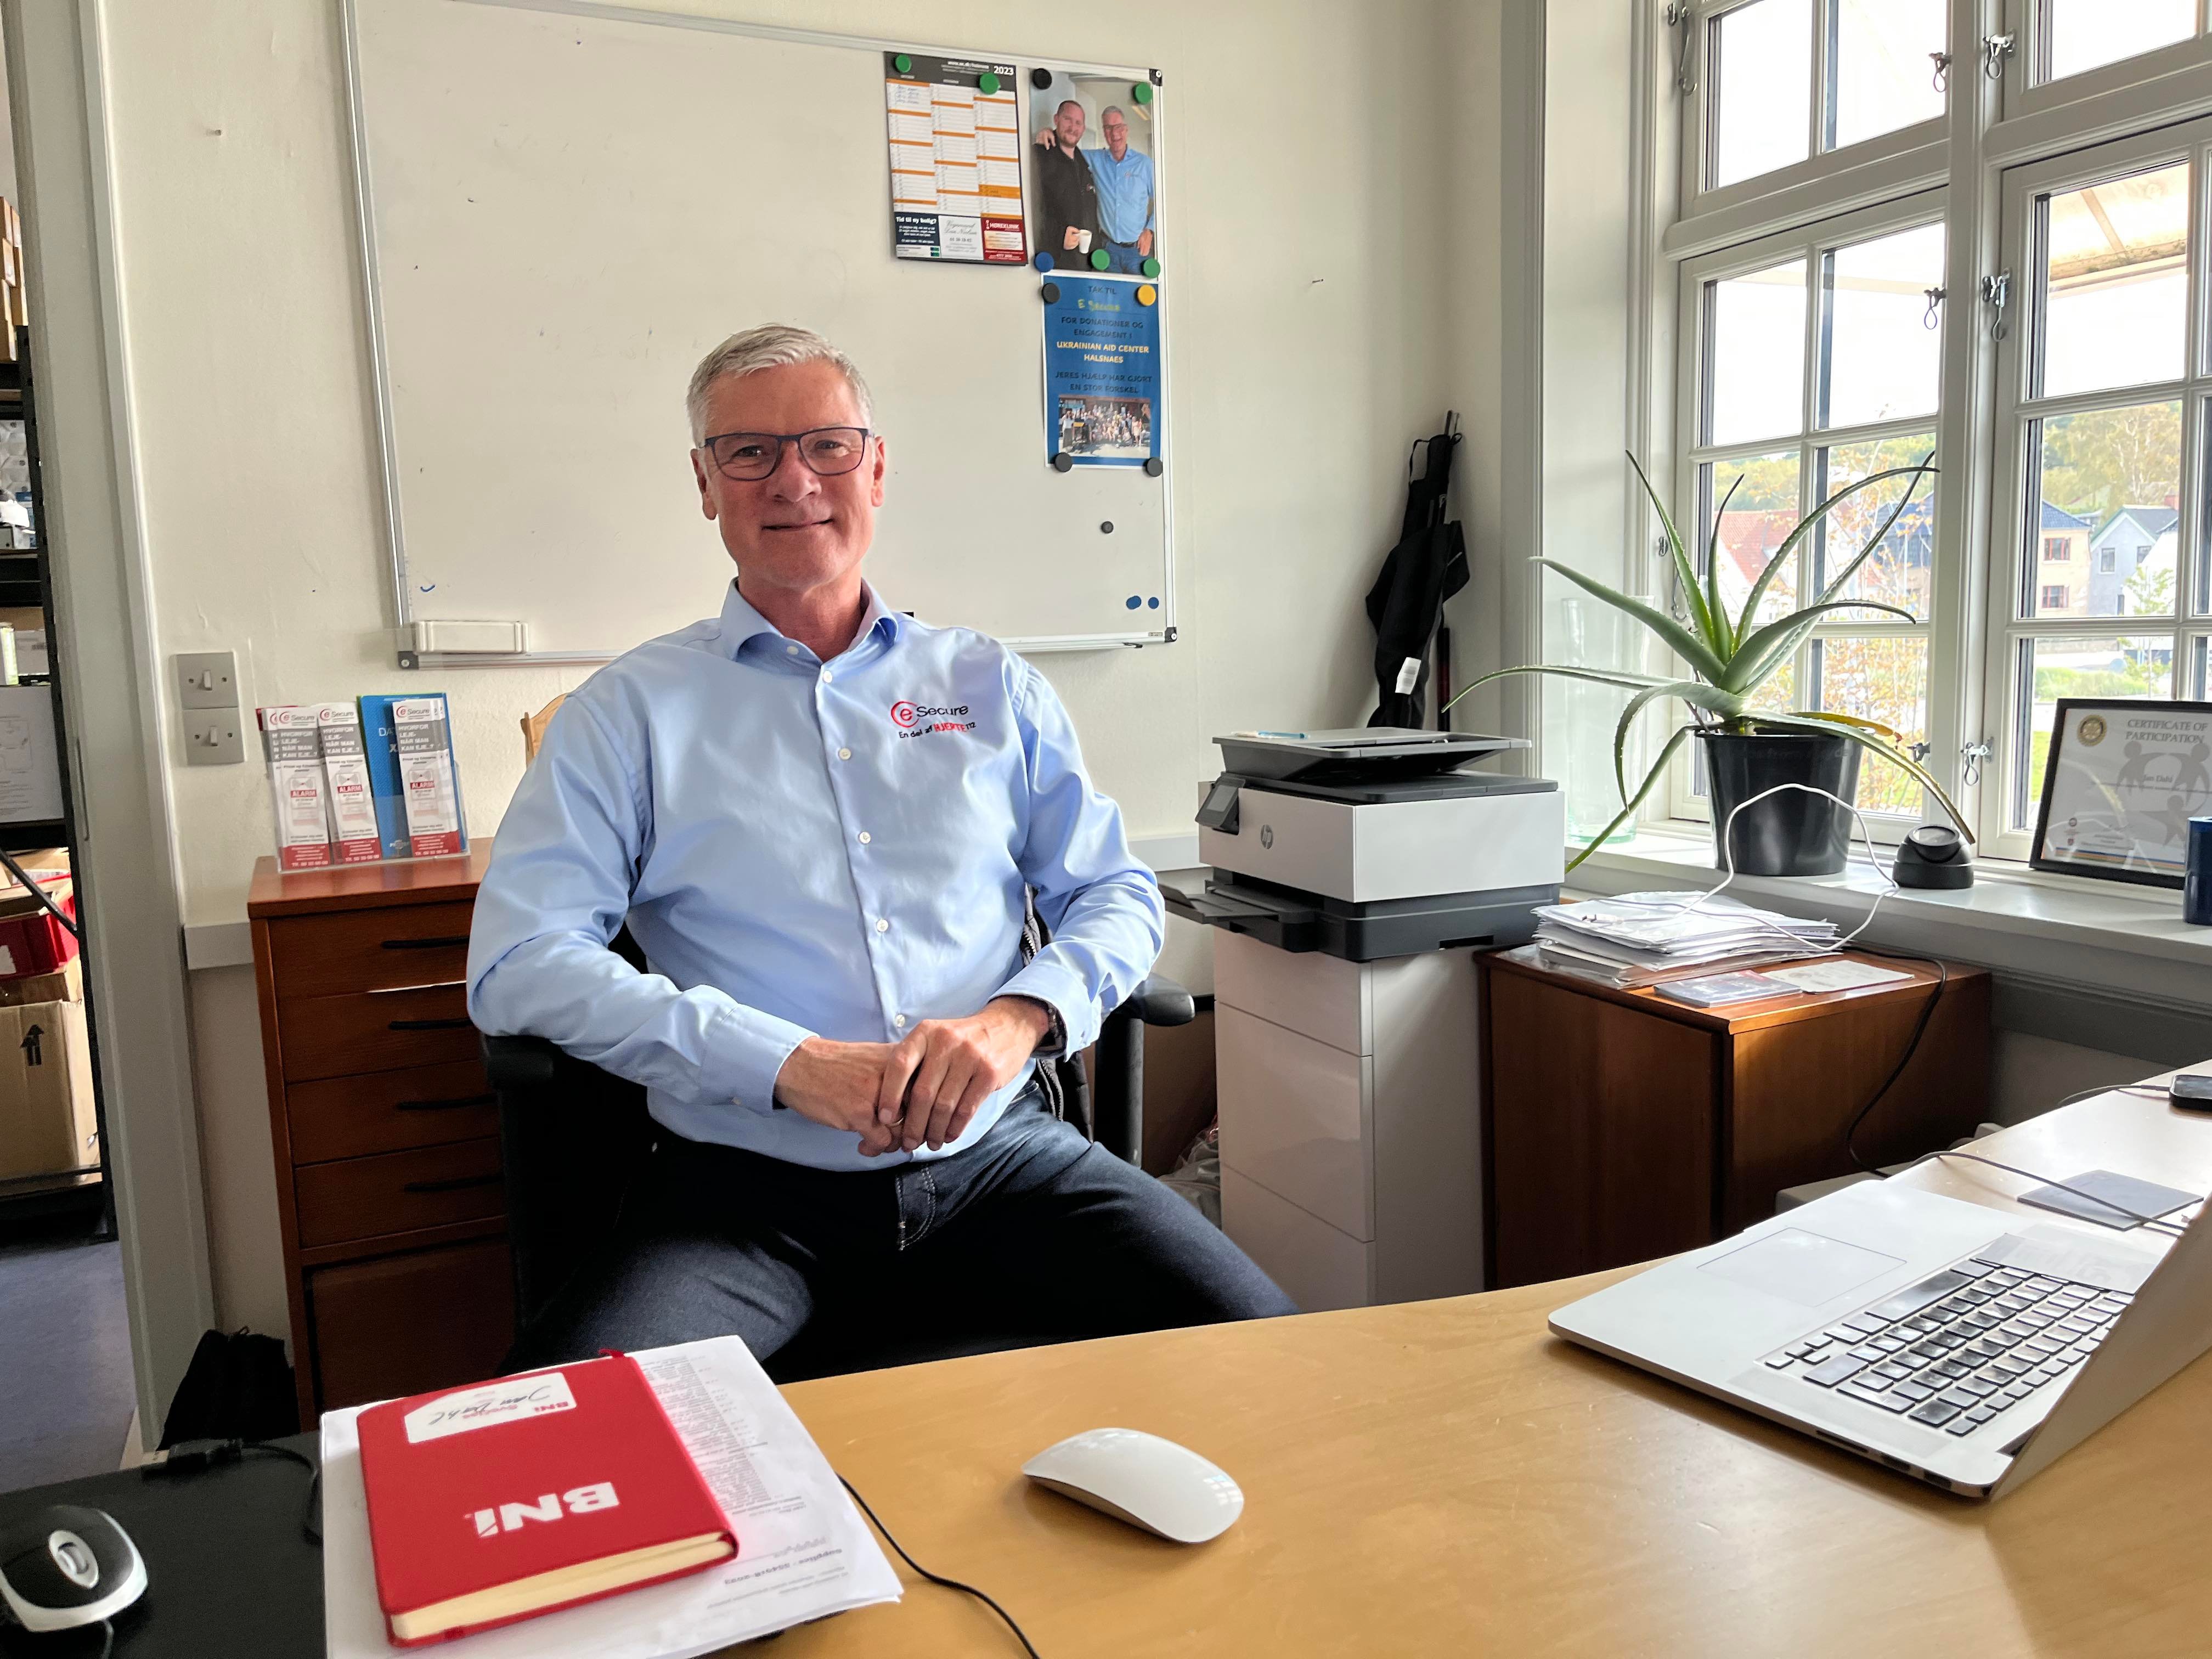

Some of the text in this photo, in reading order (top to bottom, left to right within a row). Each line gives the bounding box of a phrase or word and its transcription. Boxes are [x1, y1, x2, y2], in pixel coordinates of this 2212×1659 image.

[994, 65, 1014, 75] 2023
[1105, 286, 1116, 295] TIL
[1078, 299, 1085, 309] E
[1080, 318, 1130, 328] DONATIONER
[1074, 329, 1127, 339] ENGAGEMENT
[1057, 341, 1149, 354] UKRAINIAN AID CENTER
[1084, 354, 1124, 363] HALSNAES
[1056, 371, 1079, 379] JERES
[1105, 386, 1139, 394] FORSKEL
[916, 706, 969, 718] Secure
[2128, 719, 2208, 731] CERTIFICATE OF
[899, 731, 909, 739] En
[910, 729, 923, 737] del
[2125, 732, 2205, 743] PARTICIPATION
[1261, 825, 1273, 849] hp
[475, 1481, 620, 1538] BNI
